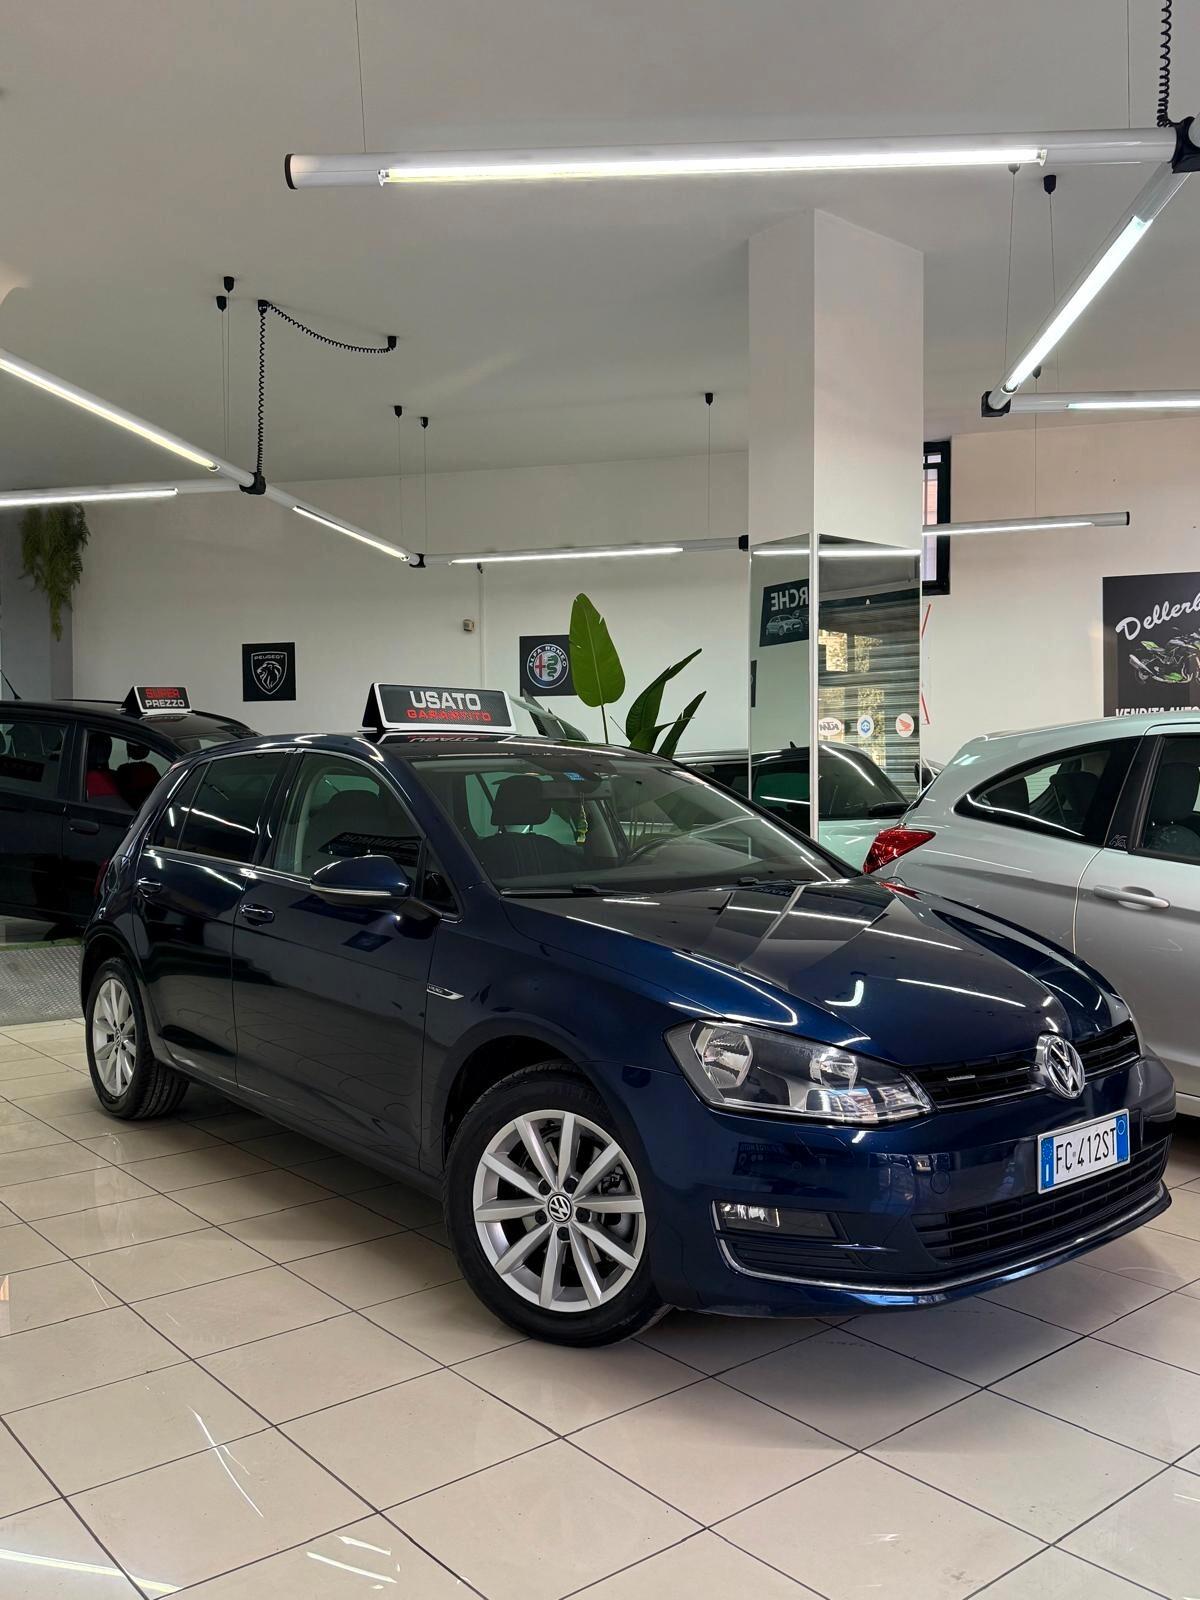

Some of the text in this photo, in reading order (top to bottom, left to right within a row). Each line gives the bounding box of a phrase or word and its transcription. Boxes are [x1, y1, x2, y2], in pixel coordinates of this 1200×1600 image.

[529, 646, 568, 667] ALFA ROMEO
[145, 699, 185, 707] PREZZO
[409, 690, 482, 711] USATO
[406, 709, 492, 721] GARANTITO
